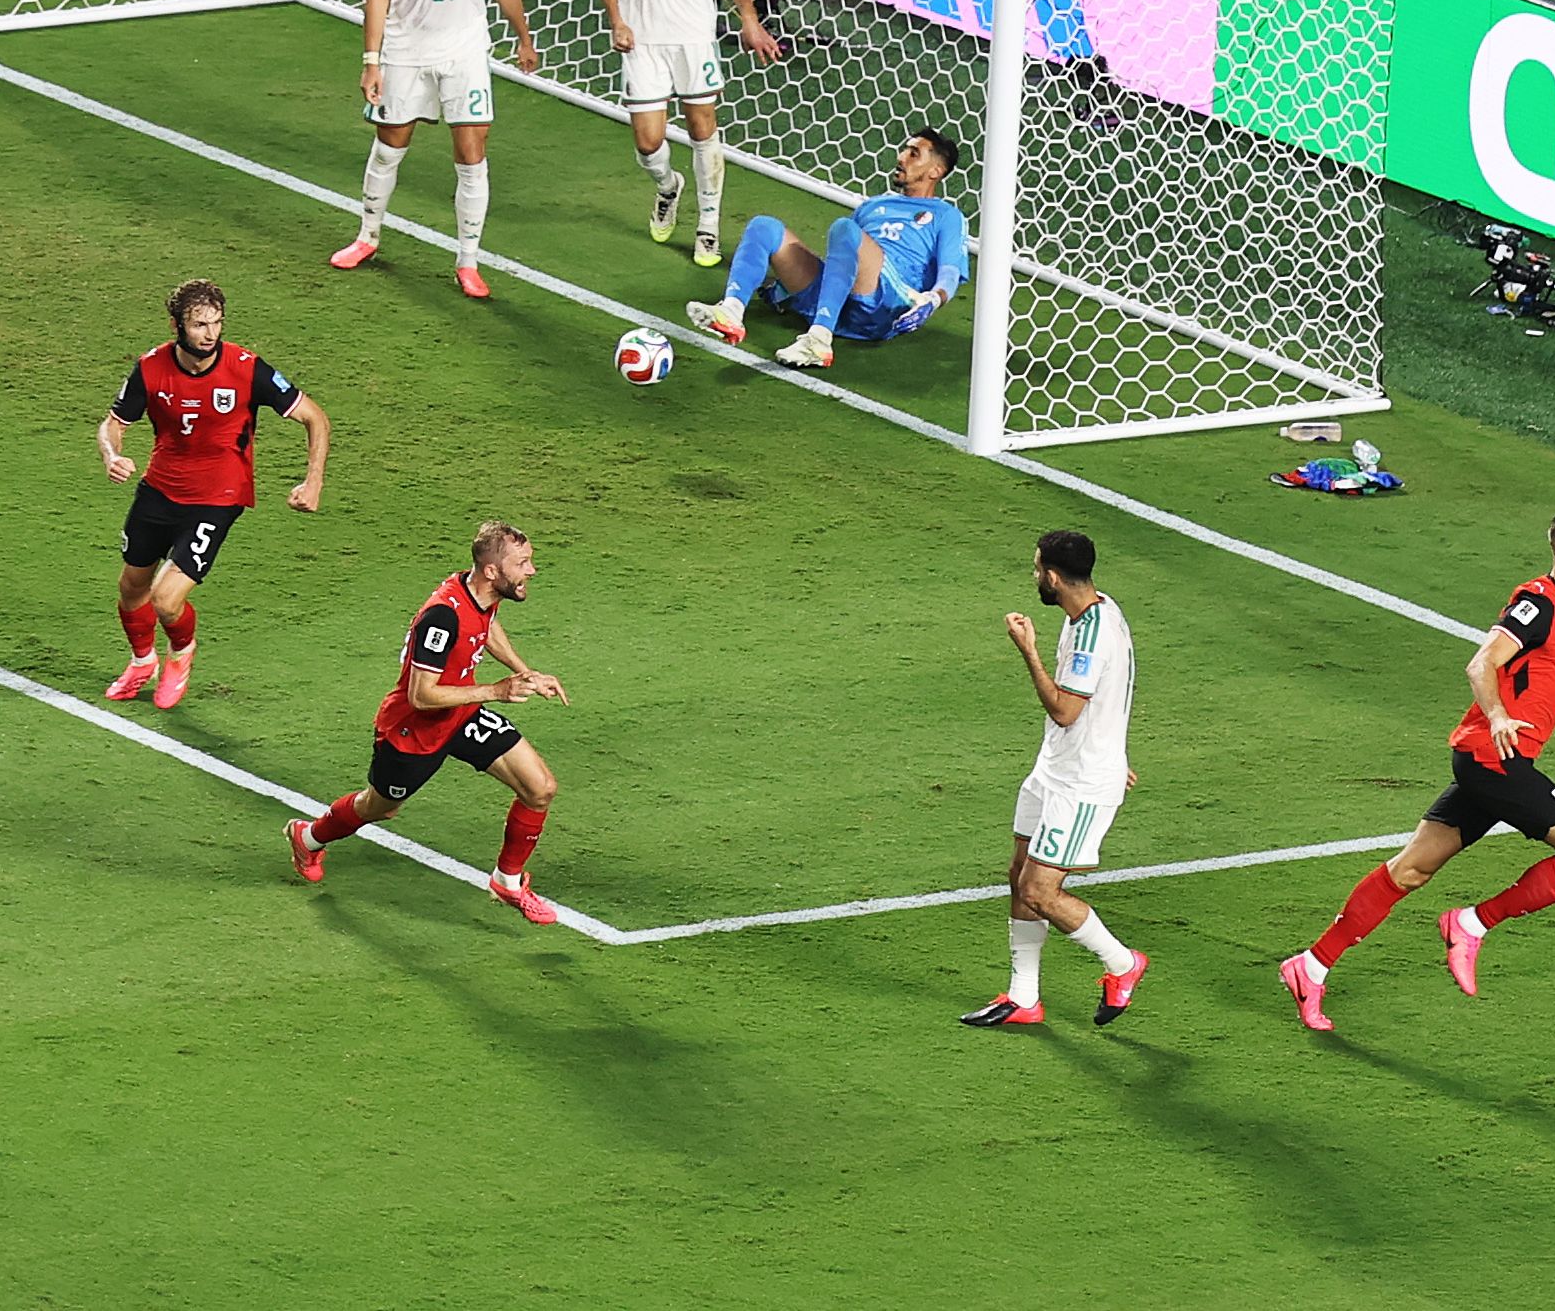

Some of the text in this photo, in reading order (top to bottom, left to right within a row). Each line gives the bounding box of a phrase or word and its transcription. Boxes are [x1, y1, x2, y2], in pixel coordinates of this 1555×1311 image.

[702, 61, 719, 87] 2
[468, 88, 490, 117] 21
[189, 521, 217, 555] 5
[464, 707, 504, 744] 20
[1034, 820, 1065, 859] 15
